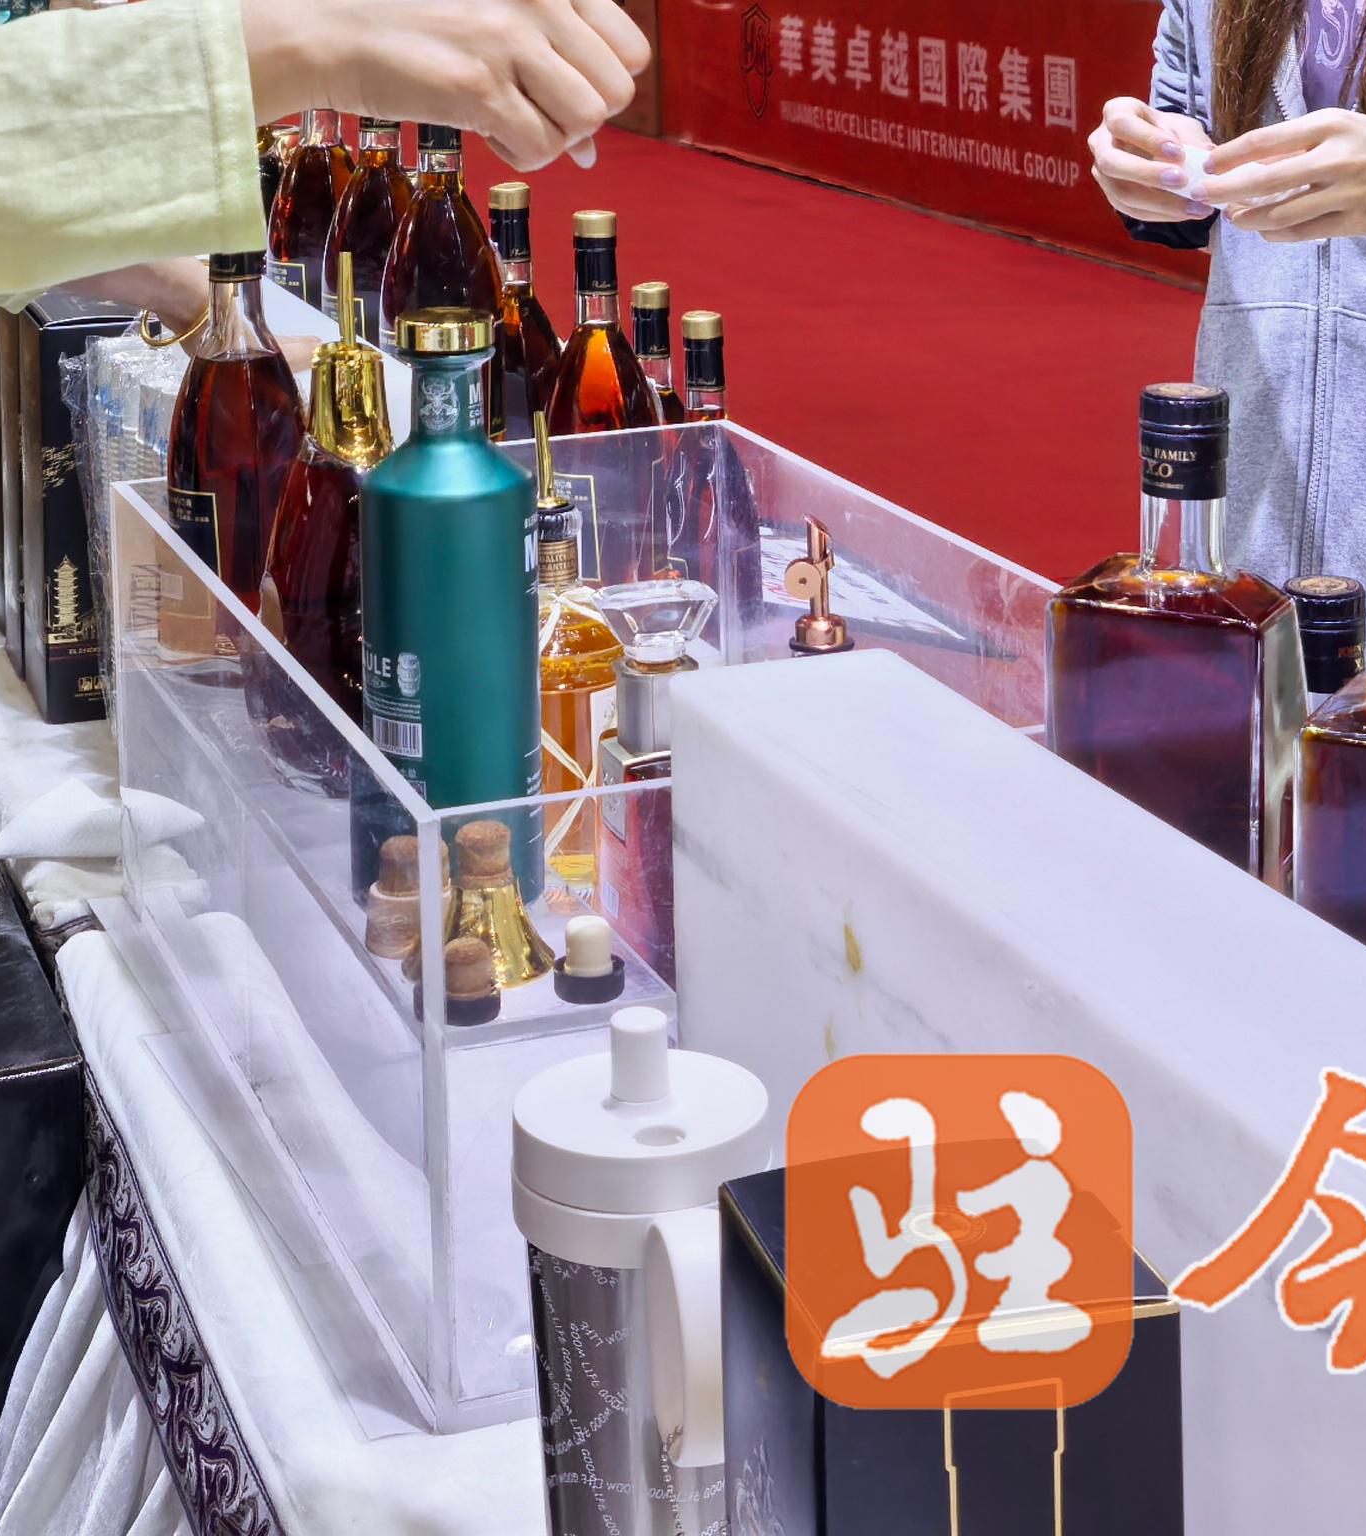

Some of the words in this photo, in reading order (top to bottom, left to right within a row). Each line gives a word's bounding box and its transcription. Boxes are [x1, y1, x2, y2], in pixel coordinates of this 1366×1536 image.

[779, 13, 1077, 132] 華美卓越國際集團
[781, 100, 823, 127] HUAMEI
[826, 110, 904, 149] EXCELLENCE
[907, 128, 1020, 176] INTERNATIONAL
[1023, 152, 1079, 188] GROUP
[1154, 448, 1197, 462] FAMILY
